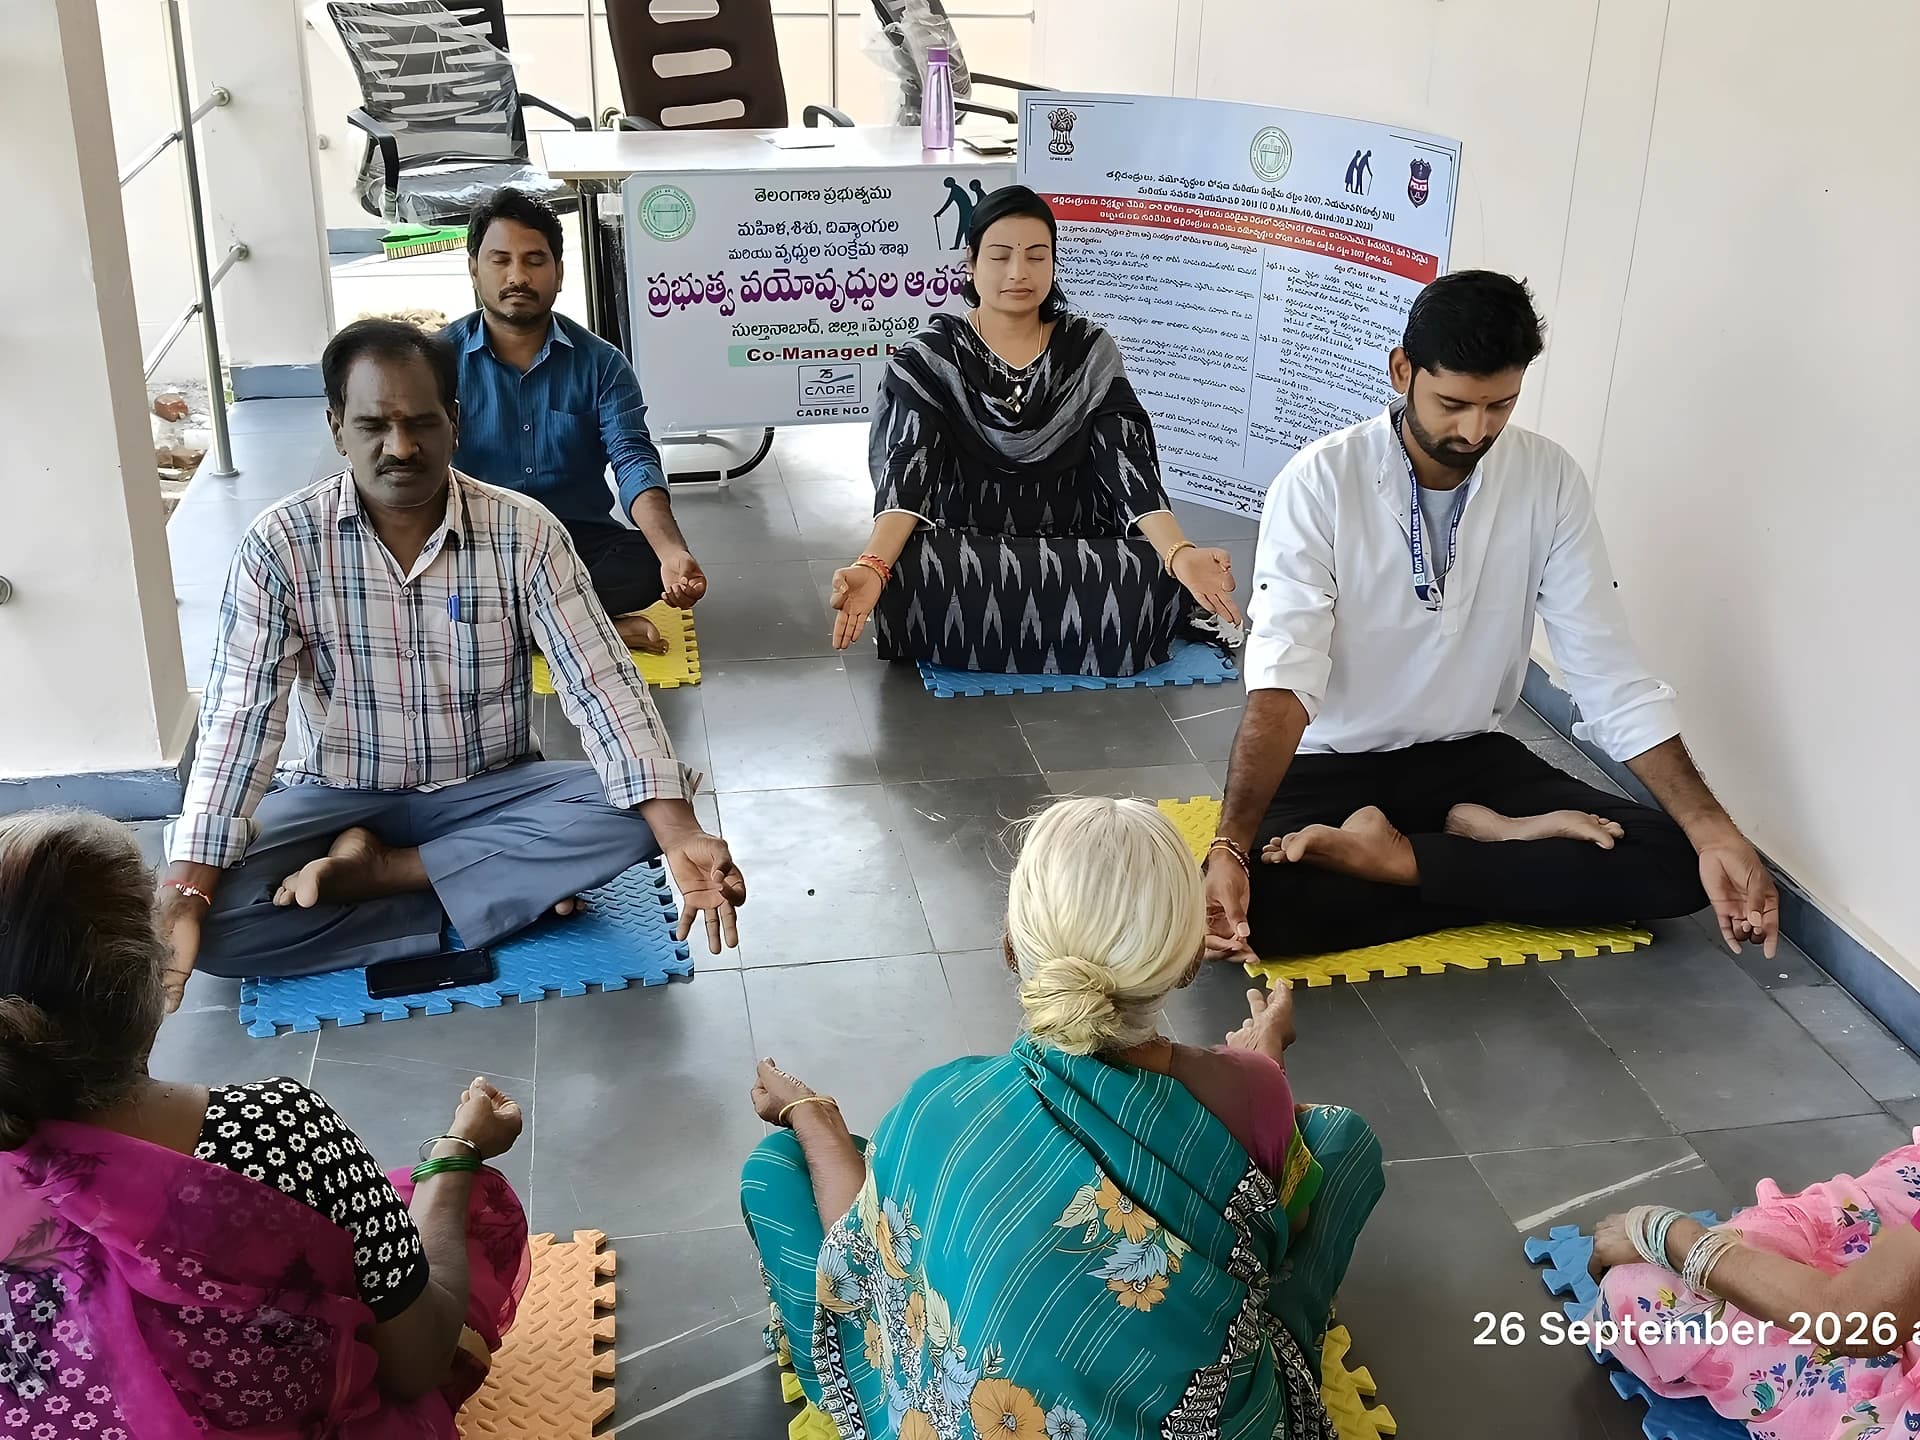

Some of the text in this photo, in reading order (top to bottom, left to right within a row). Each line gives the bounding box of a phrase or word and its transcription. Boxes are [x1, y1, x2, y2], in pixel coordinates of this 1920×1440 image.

[754, 185, 892, 204] తెలంగాణ ప్రభుత్వము
[826, 218, 899, 238] దివ్యాంగుల
[728, 248, 772, 260] మరియు
[824, 238, 876, 260] సంక్షేమ
[879, 242, 909, 257] శాఖ
[647, 270, 736, 318] ప్రభుత్వ
[746, 343, 898, 362] Co-Managed b
[805, 385, 855, 395] CADRE
[796, 406, 869, 417] CADRE NGO
